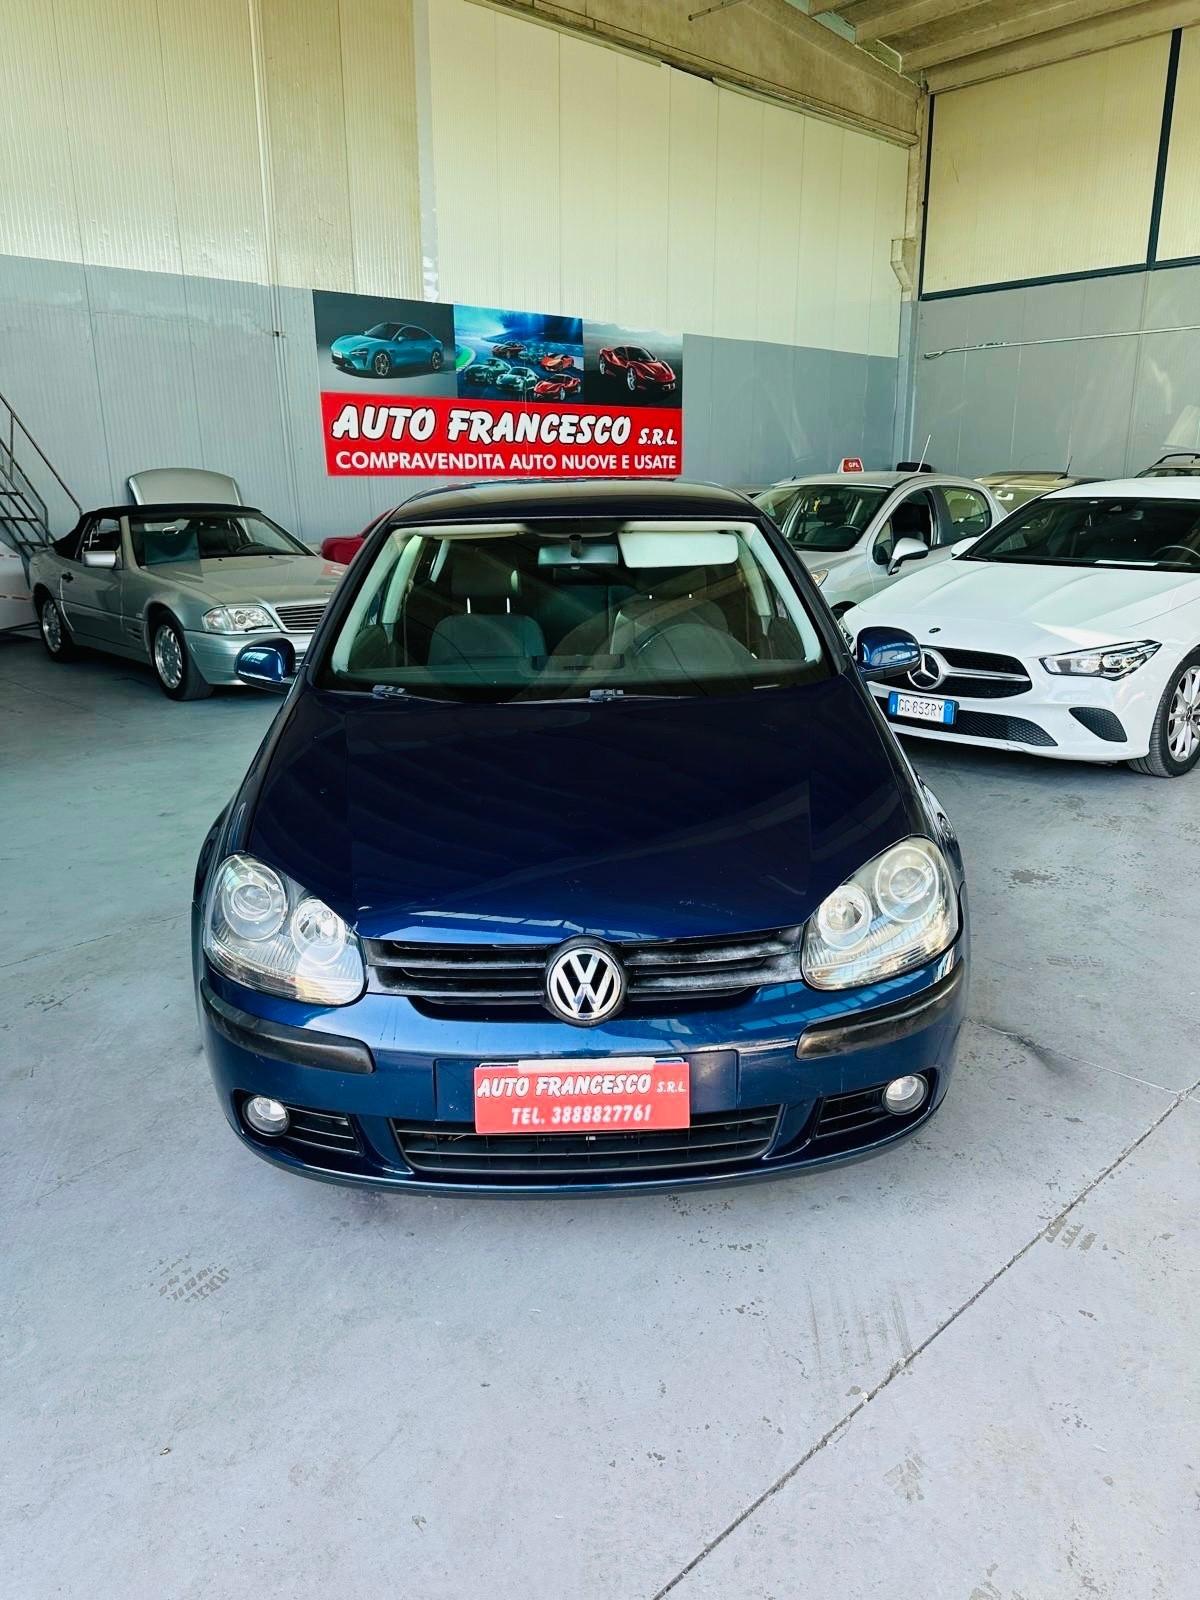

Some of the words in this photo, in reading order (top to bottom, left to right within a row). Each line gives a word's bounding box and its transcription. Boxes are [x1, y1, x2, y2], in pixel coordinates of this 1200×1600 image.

[331, 404, 436, 441] AUTO
[447, 409, 632, 445] FRANCESCO
[335, 450, 506, 470] COMPRAVENDITA
[509, 452, 557, 471] AUTO
[561, 454, 617, 471] NUOVE
[621, 455, 630, 470] E
[633, 454, 677, 470] USATE
[476, 1077, 530, 1098] AUTO
[535, 1074, 651, 1097] FRANCESCO
[511, 1107, 545, 1125] TEL.
[551, 1104, 652, 1124] 3888827761
